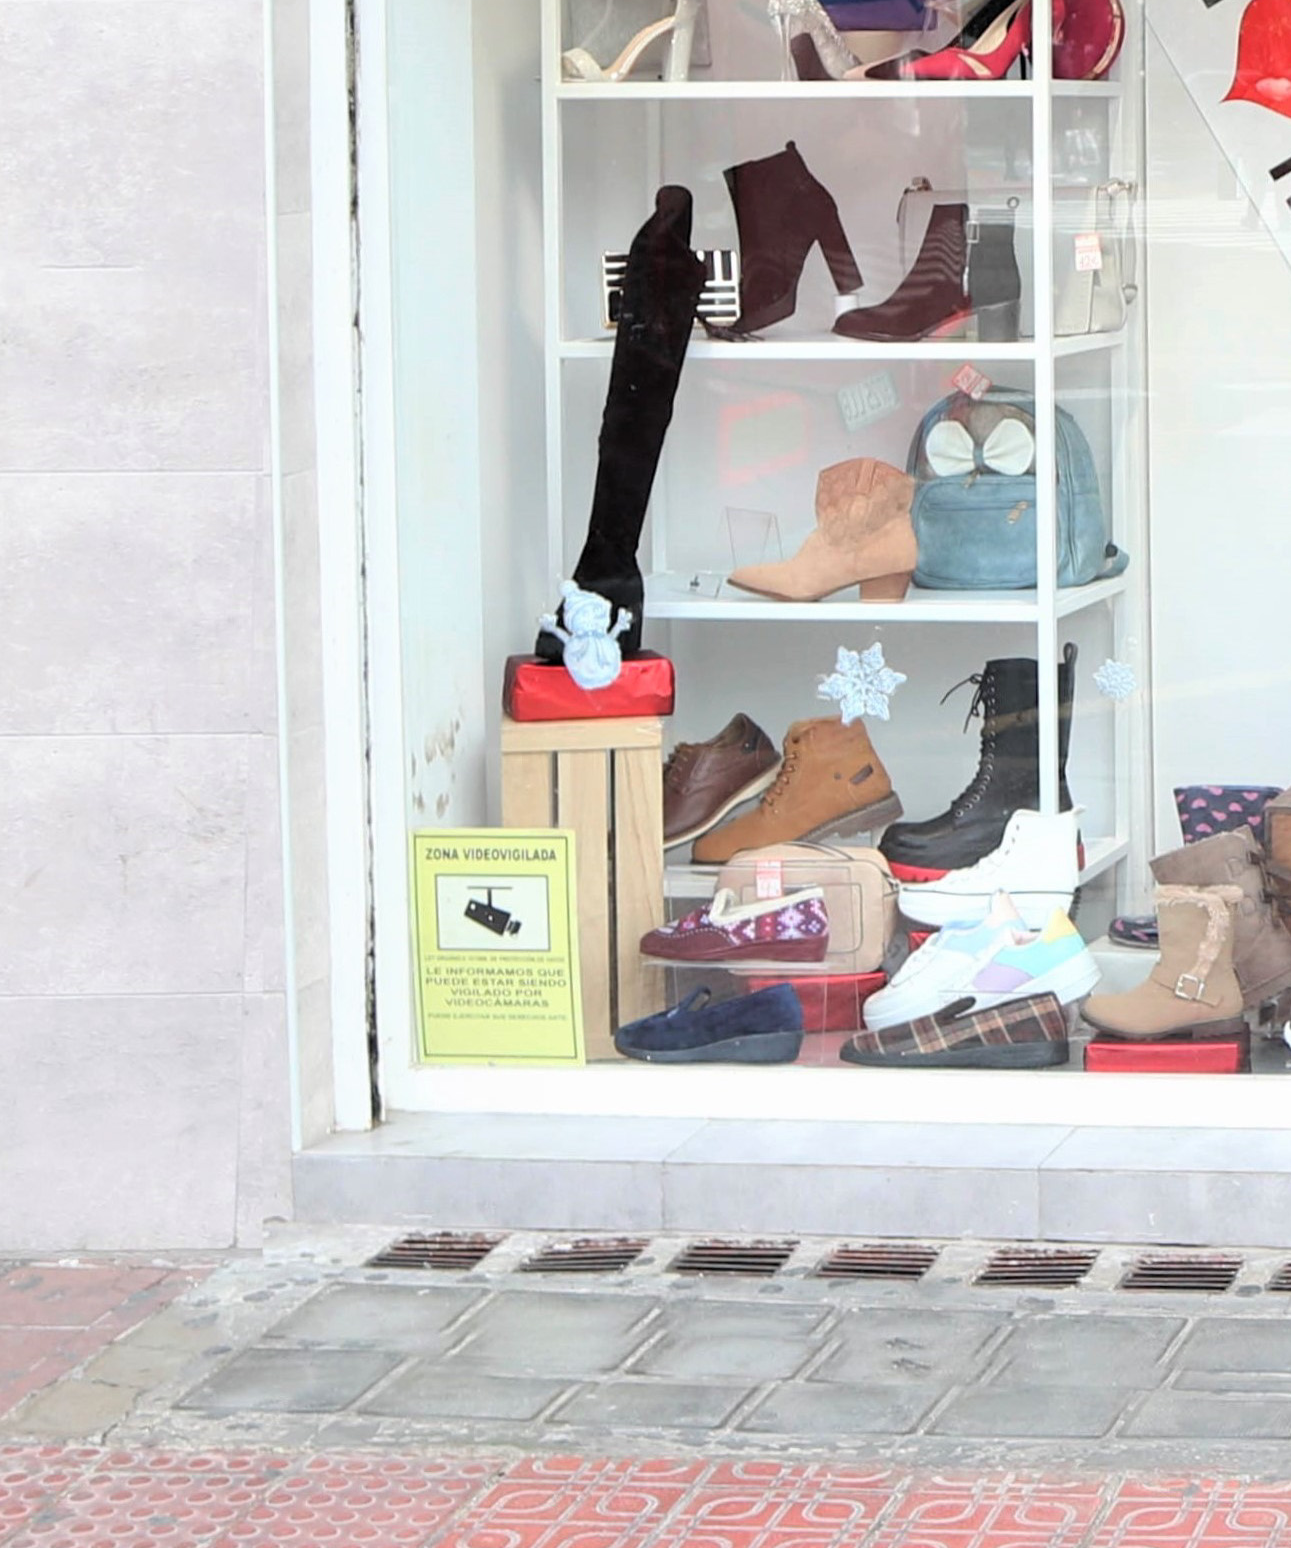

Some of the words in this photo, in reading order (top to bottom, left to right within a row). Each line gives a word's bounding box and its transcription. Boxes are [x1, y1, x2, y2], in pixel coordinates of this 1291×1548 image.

[425, 848, 459, 860] ZONA
[463, 848, 557, 861] VIDEOVIGILADA
[426, 967, 442, 975] LE
[446, 967, 533, 976] INFORMAMOS
[537, 968, 564, 977] QUE
[425, 977, 468, 986] PUEDE
[473, 978, 514, 986] ESTAR
[518, 978, 567, 987] SIENDO
[451, 987, 512, 997] VIGILADO
[515, 989, 542, 997] POR
[445, 997, 549, 1008] VIDEOCÁMARAS
